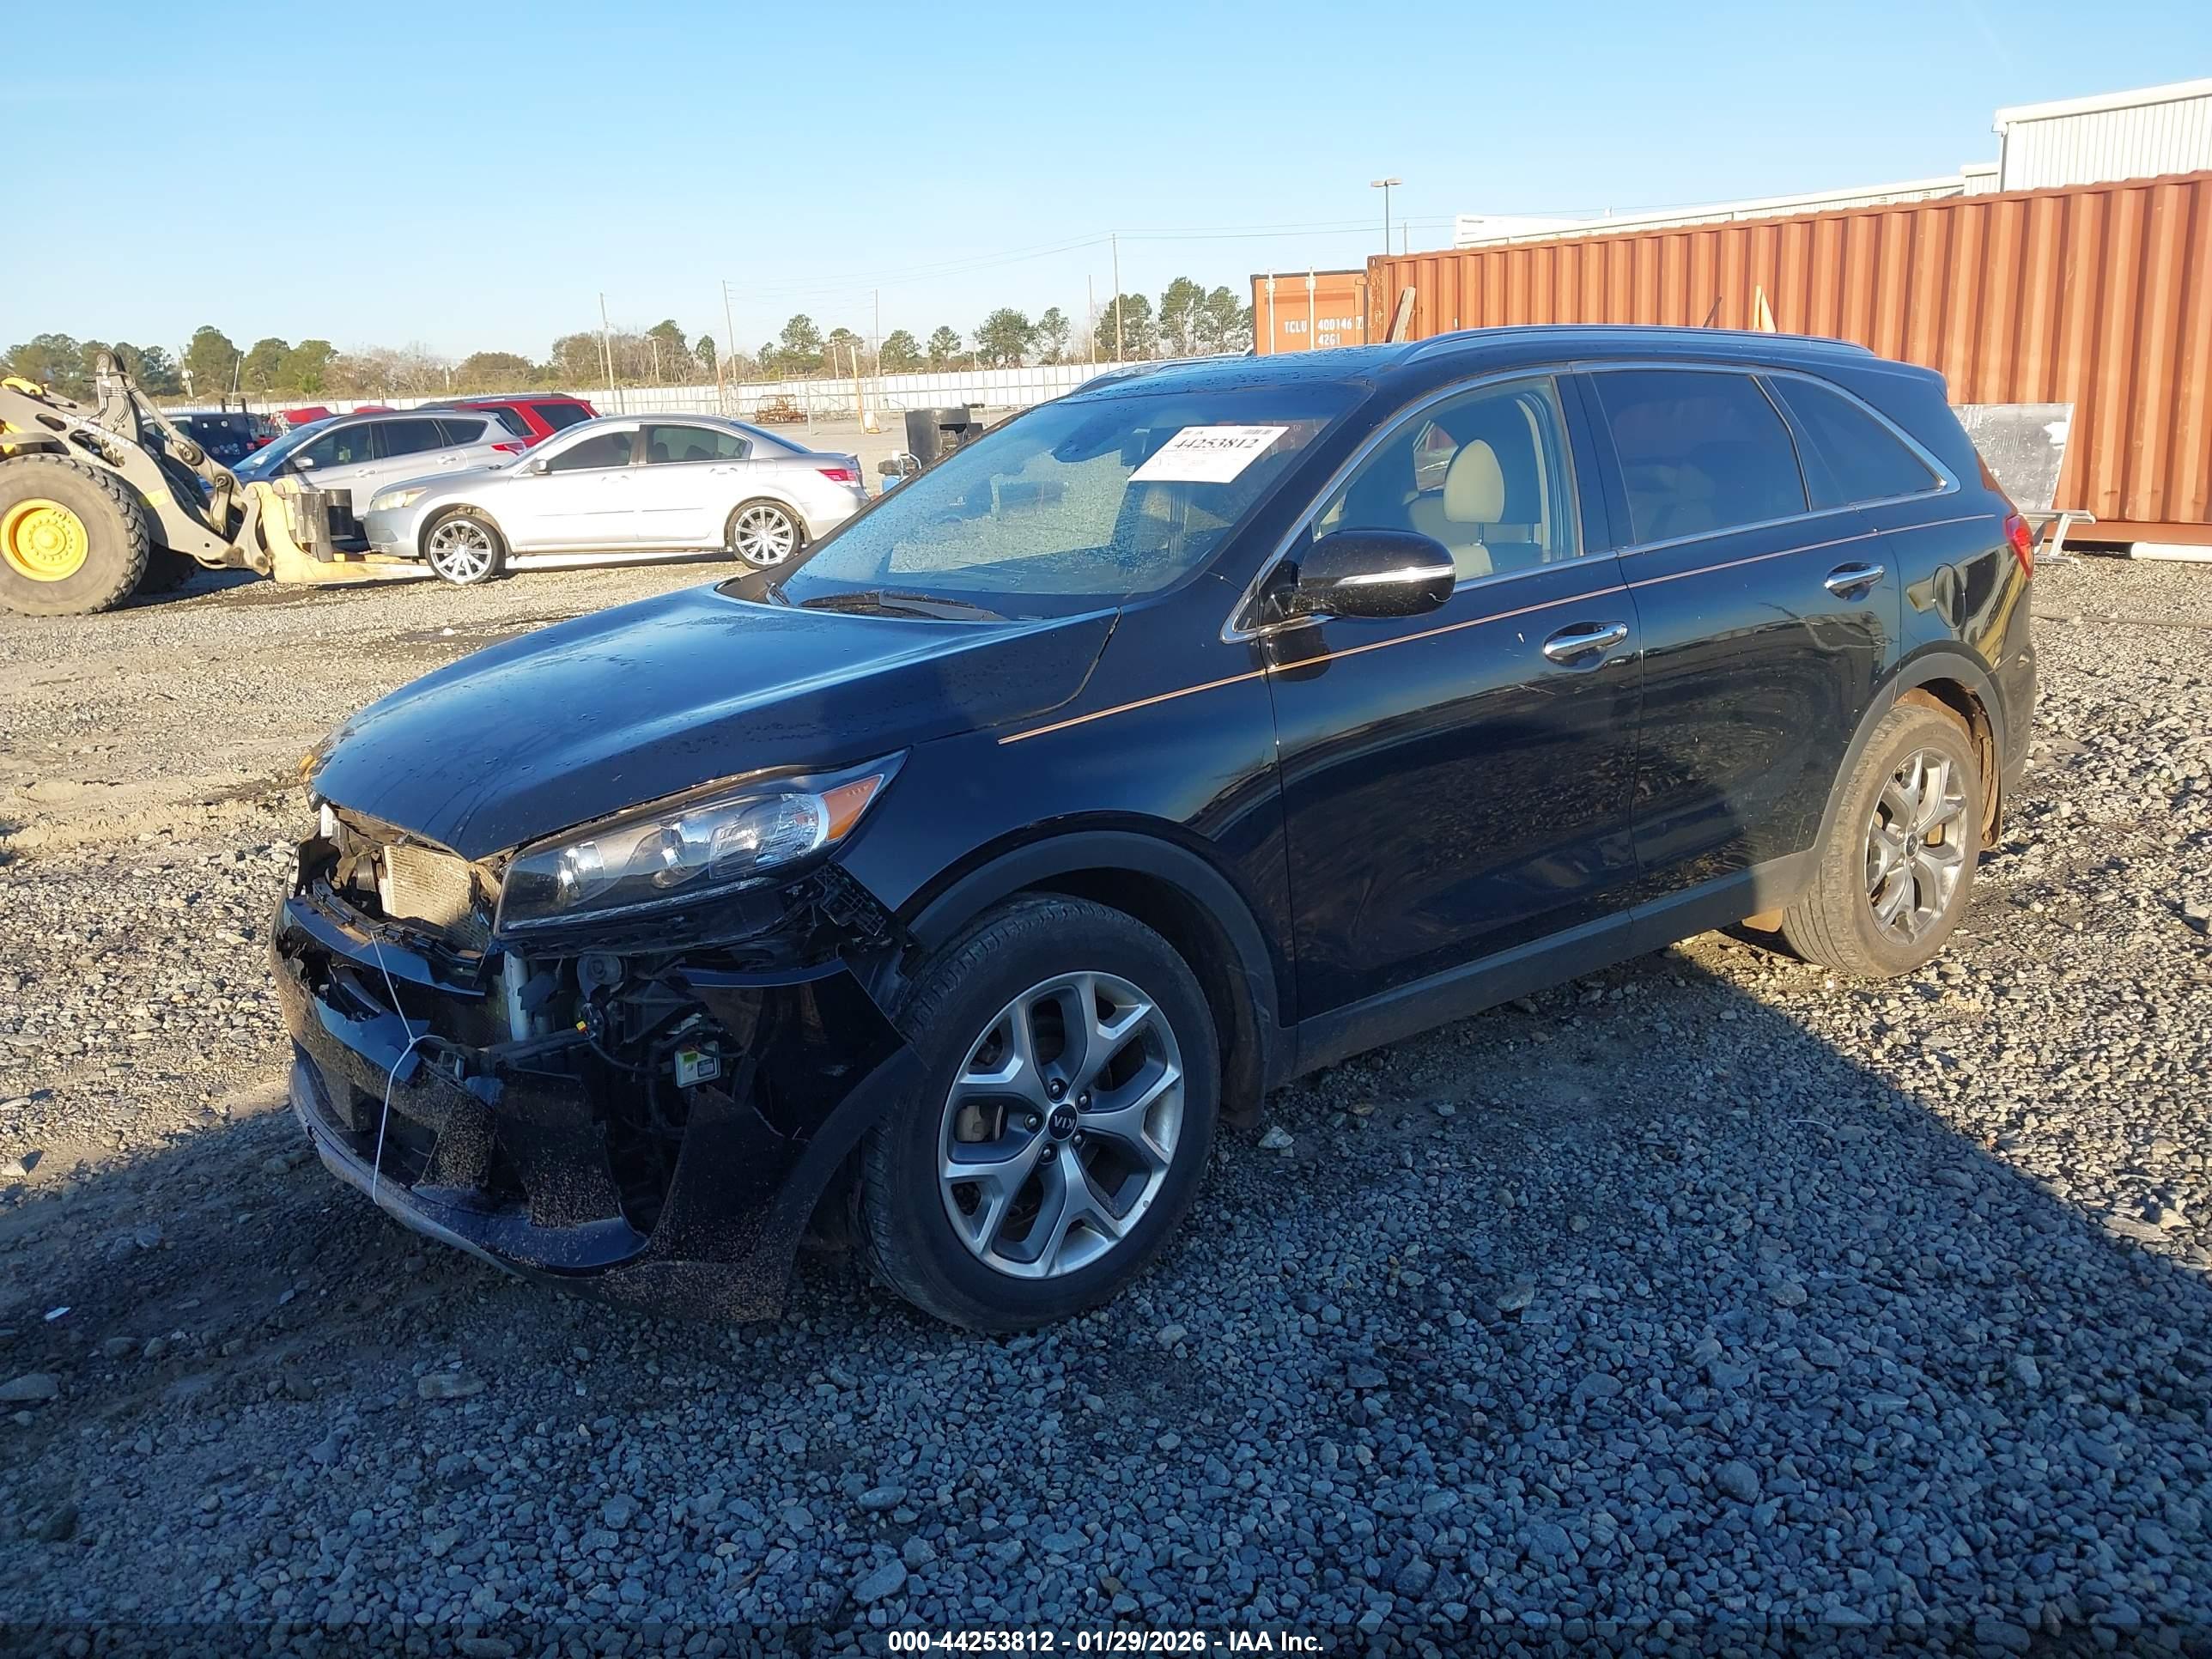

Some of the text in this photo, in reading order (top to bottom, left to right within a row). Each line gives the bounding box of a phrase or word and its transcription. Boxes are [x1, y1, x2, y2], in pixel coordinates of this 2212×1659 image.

[1284, 317, 1364, 334] TCLU 400146 7
[1318, 333, 1340, 344] 42G1
[63, 414, 79, 426] DO
[81, 421, 102, 436] NOT
[106, 431, 133, 450] WALK
[1174, 438, 1260, 449] 44253812
[1054, 1115, 1076, 1130] KIA
